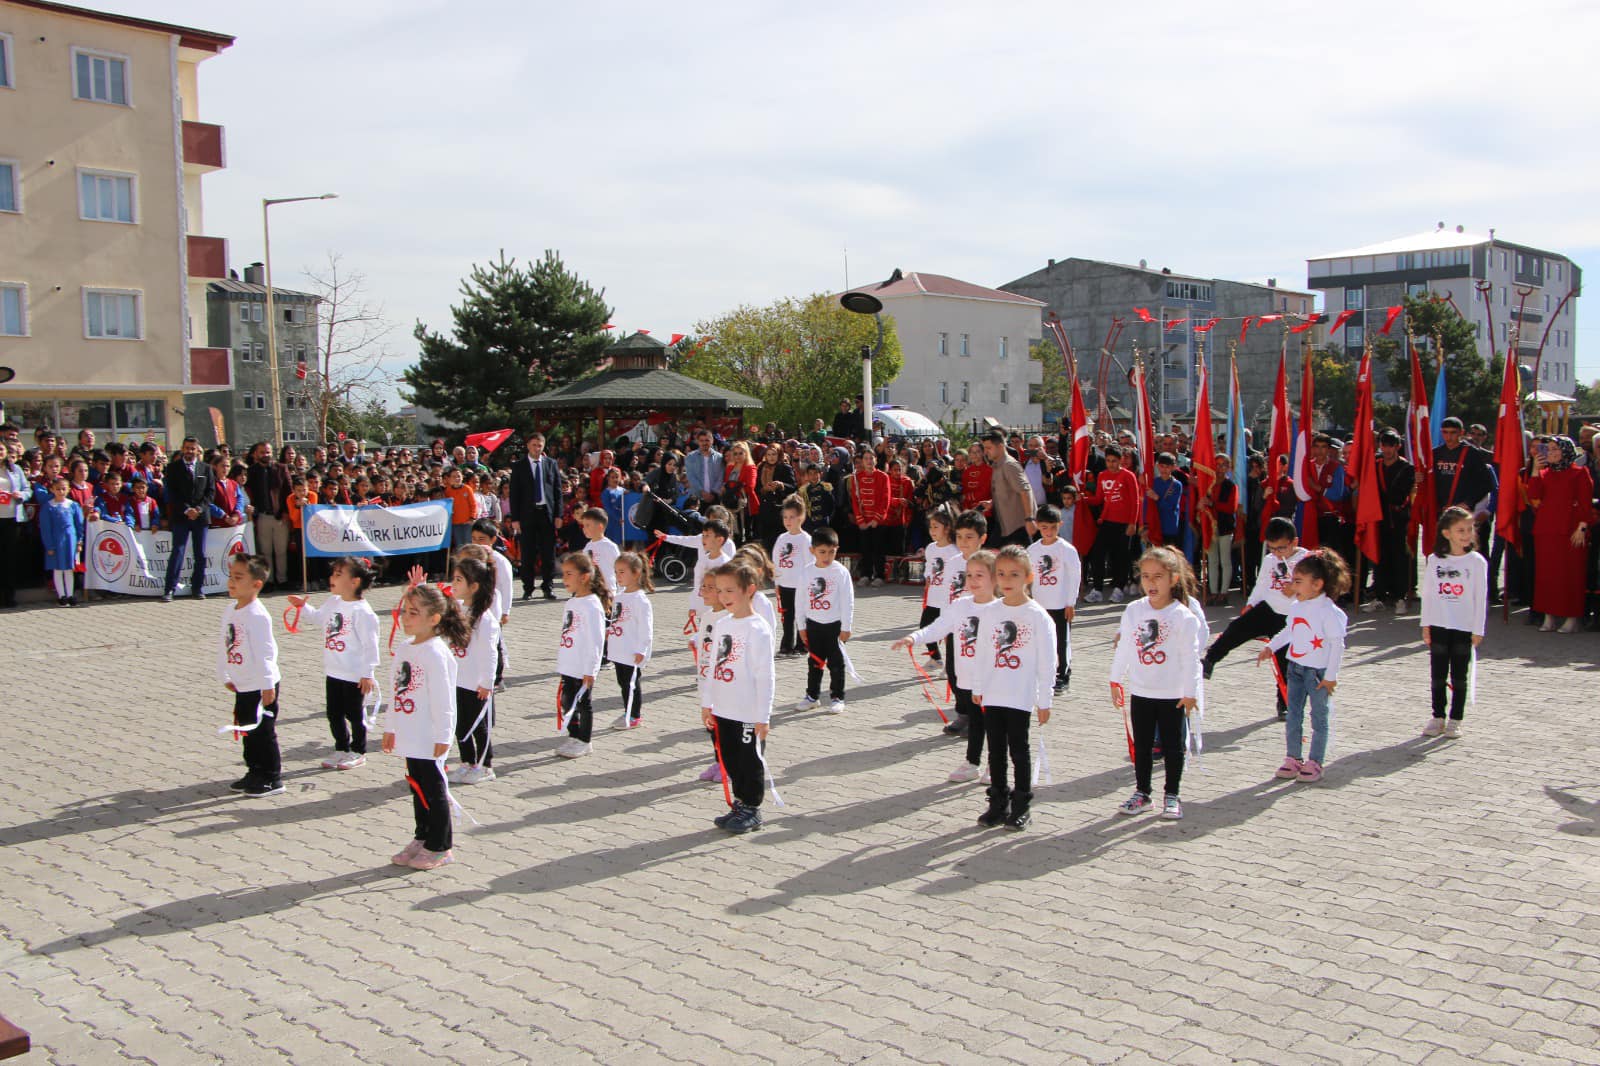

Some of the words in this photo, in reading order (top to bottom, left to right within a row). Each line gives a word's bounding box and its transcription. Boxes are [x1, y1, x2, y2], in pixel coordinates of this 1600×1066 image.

[393, 522, 444, 541] İLKOKULU
[1039, 576, 1058, 586] 100
[810, 600, 831, 610] 100
[961, 645, 975, 658] 10
[1137, 650, 1166, 665] 100
[995, 653, 1020, 670] 100
[742, 727, 752, 743] 5
